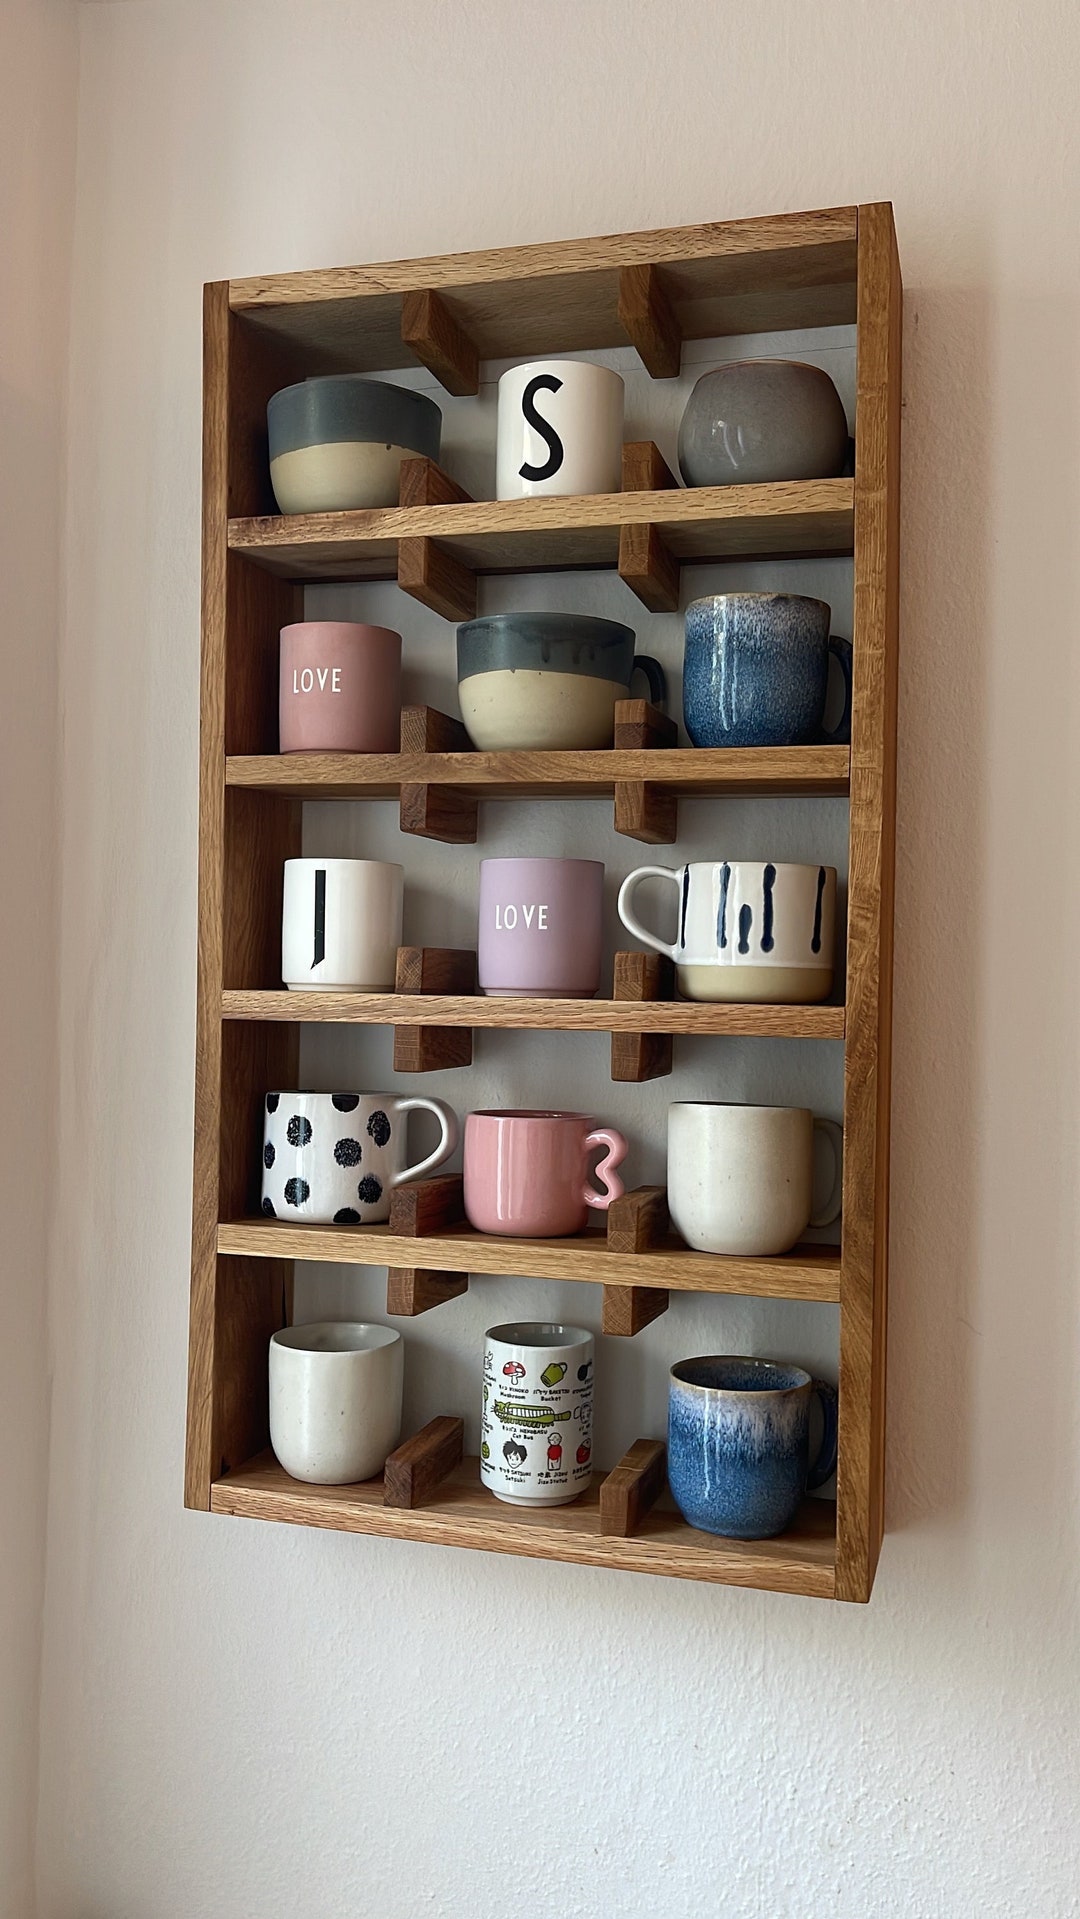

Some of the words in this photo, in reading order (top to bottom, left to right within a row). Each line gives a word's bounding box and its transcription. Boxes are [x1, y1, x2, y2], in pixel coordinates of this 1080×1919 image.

[518, 374, 564, 482] S
[293, 668, 342, 694] LOVE
[310, 869, 326, 970] J
[495, 904, 549, 930] LOVE
[500, 1391, 526, 1400] Mushroom
[505, 1474, 526, 1483] Satsuki
